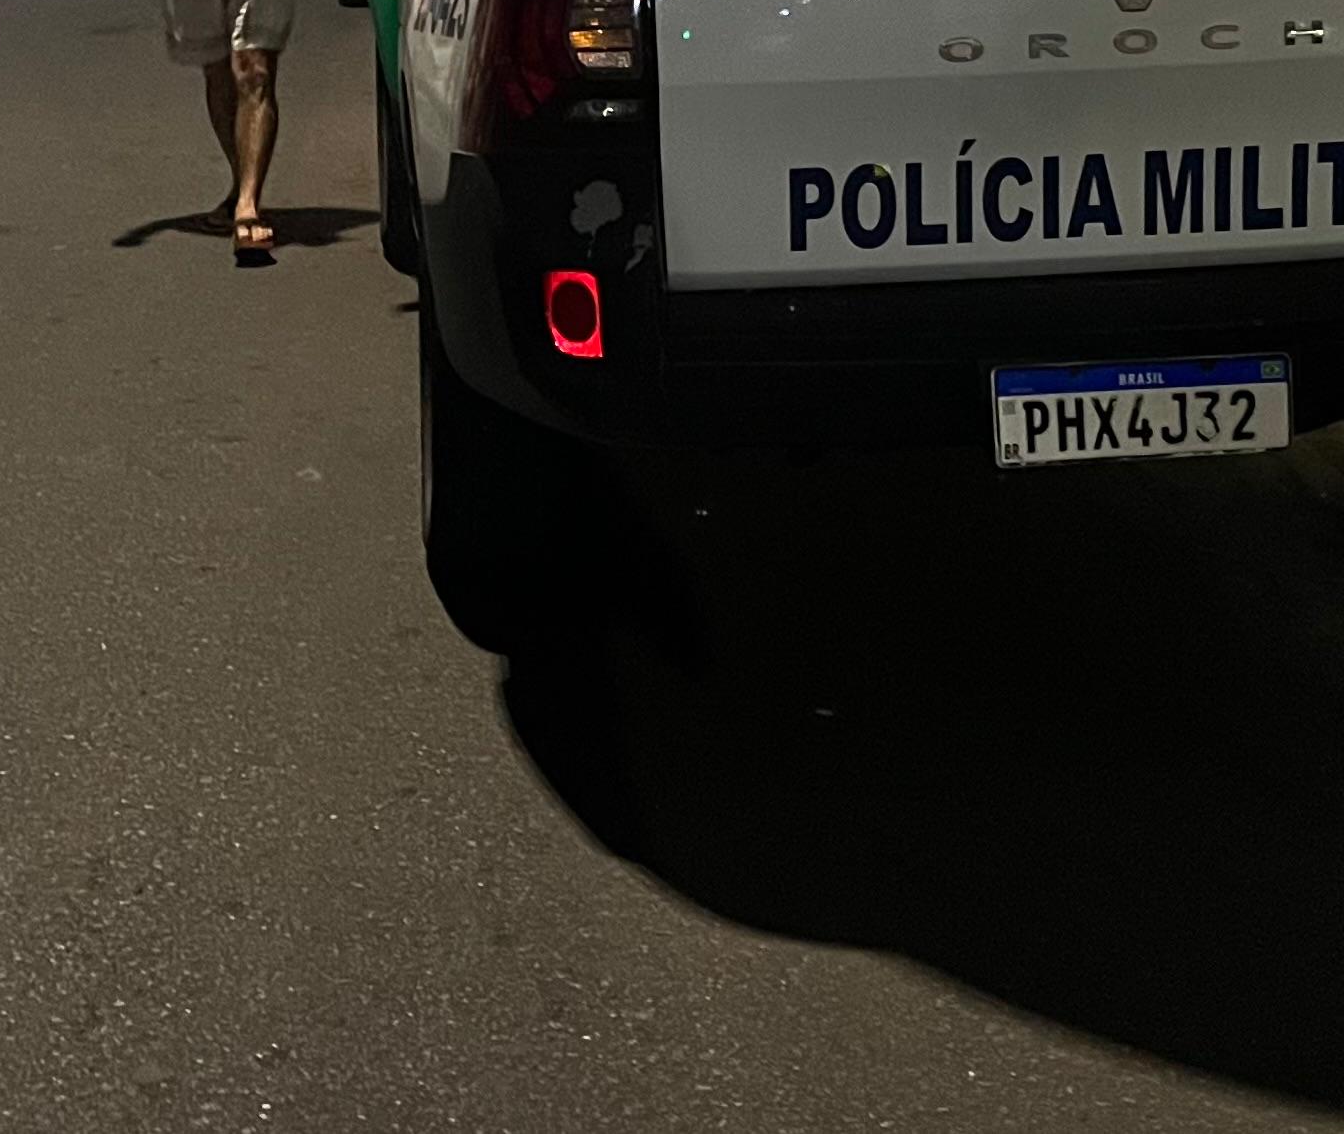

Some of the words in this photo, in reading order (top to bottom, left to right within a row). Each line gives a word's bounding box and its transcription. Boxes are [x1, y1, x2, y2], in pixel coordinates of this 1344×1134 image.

[938, 19, 1325, 63] OROCH
[788, 138, 1123, 252] POLÍCIA
[1118, 371, 1166, 387] BRASIL
[1022, 389, 1258, 454] PHX4J32
